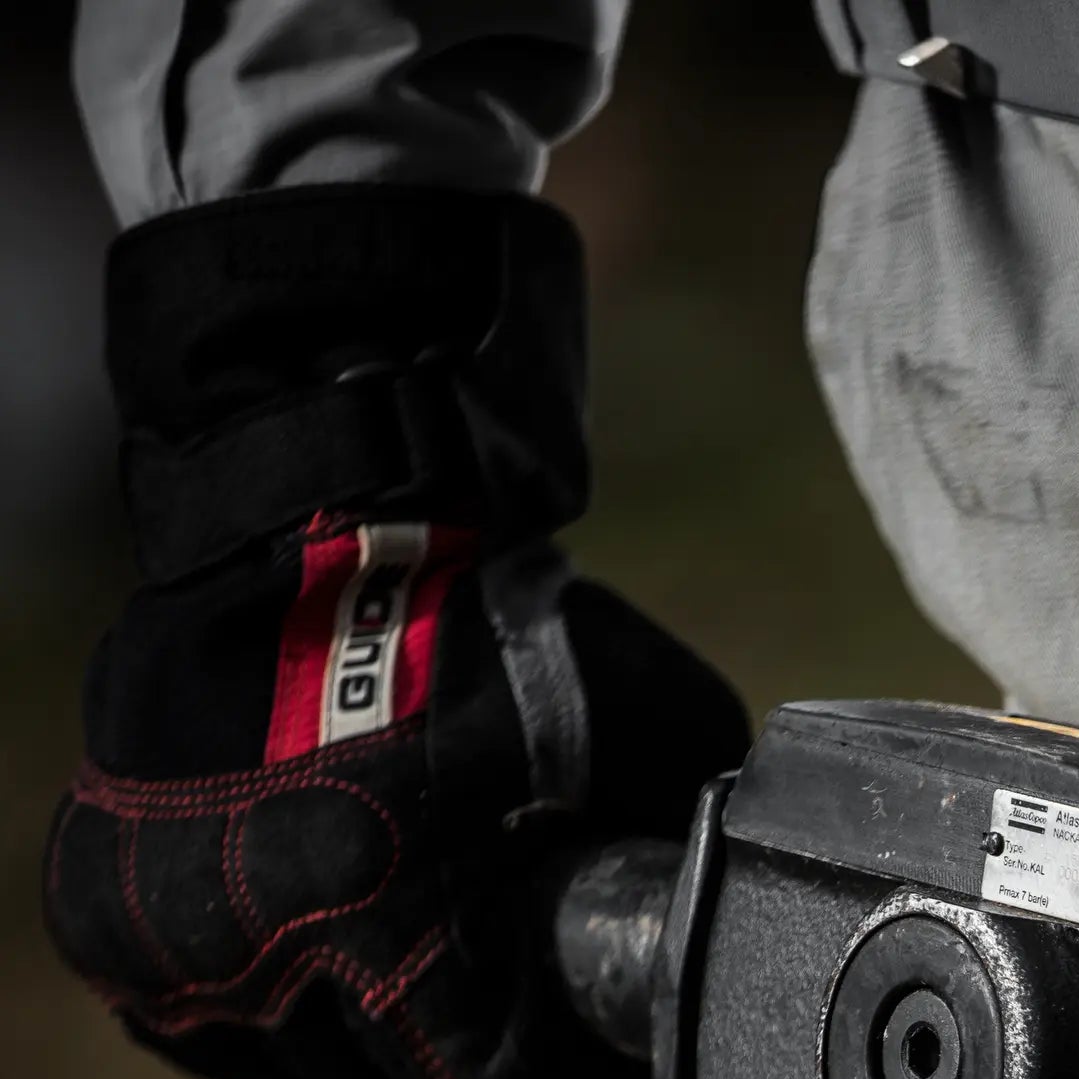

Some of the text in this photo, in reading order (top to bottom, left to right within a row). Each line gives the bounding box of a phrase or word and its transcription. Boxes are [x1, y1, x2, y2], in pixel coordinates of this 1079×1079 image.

[1056, 810, 1079, 828] Atlas
[999, 884, 1049, 908] Pmax 7 bar(e)
